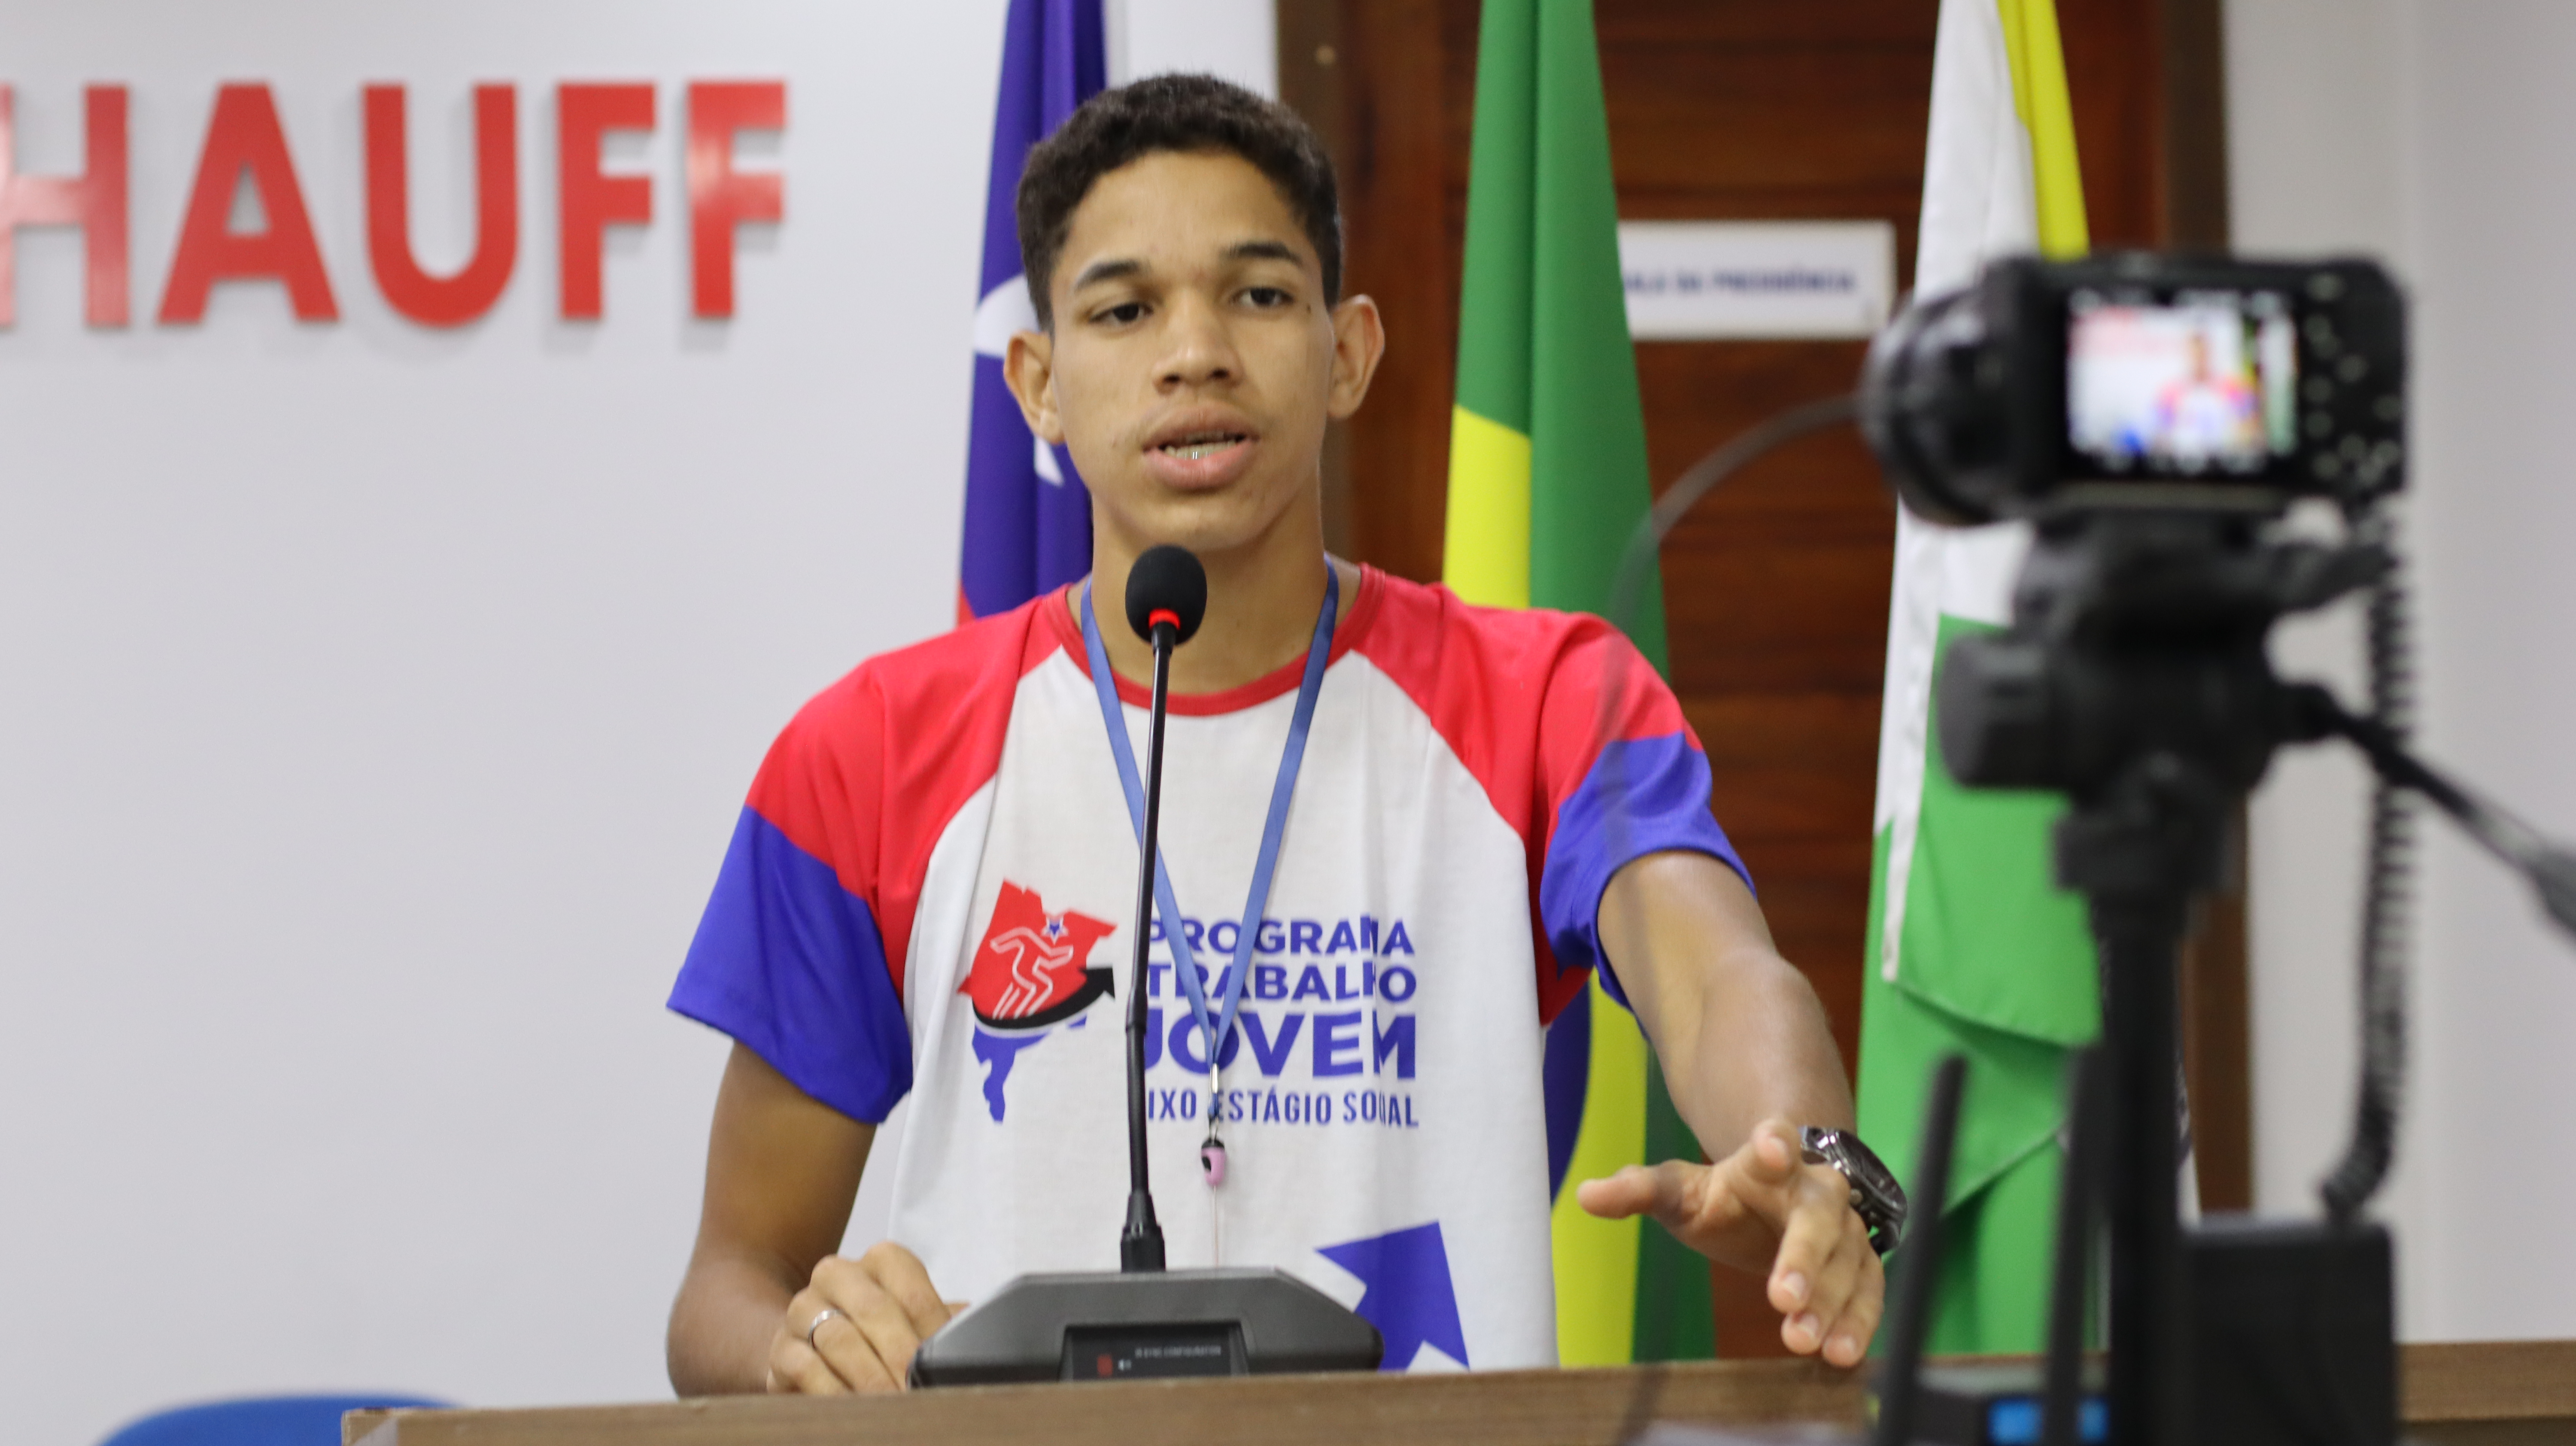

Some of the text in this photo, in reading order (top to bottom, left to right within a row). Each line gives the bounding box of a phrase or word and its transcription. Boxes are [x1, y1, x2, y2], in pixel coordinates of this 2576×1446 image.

[0, 80, 787, 327] HAUFF
[1144, 1009, 1416, 1079] JOVEM
[1148, 1089, 1197, 1121] IXO
